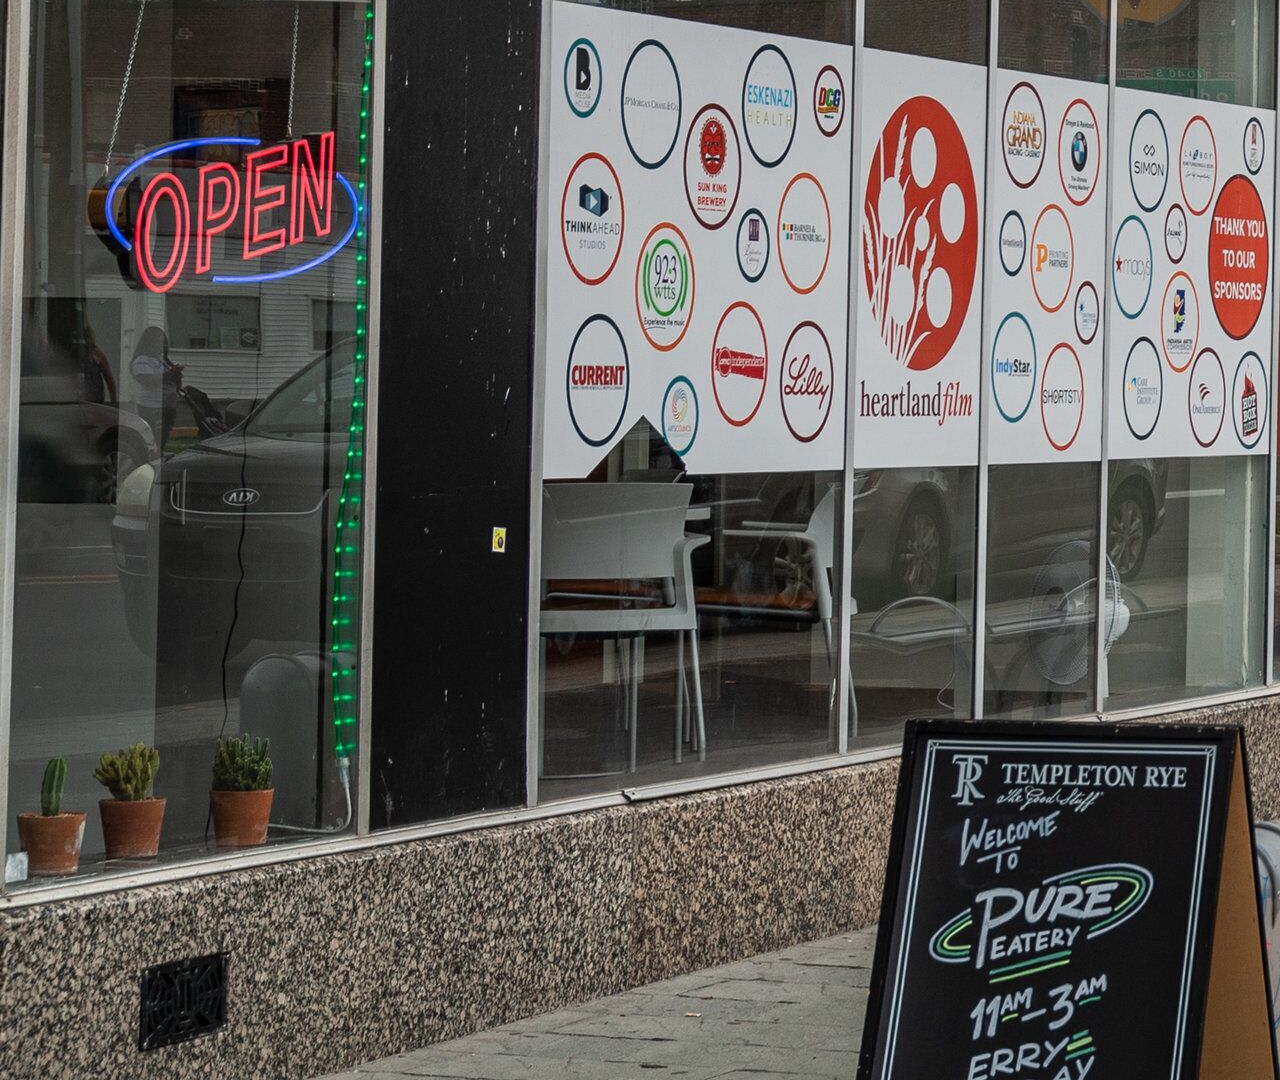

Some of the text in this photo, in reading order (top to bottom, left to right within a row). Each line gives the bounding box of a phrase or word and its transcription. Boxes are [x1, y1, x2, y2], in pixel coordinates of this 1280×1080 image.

[747, 85, 793, 108] ESKENAZI
[818, 87, 841, 107] DCG
[747, 110, 792, 127] HEALTH
[1007, 124, 1042, 150] GRAND
[1134, 160, 1164, 177] SIMON
[697, 182, 727, 194] SUN KING
[697, 196, 726, 207] BREWERY
[134, 131, 336, 294] OPEN
[565, 220, 620, 235] THINKAHEAD
[1214, 216, 1265, 238] THANK YOU
[579, 240, 606, 250] STUDIOS
[1223, 250, 1255, 269] TO OUR
[1214, 280, 1262, 301] SPONSORS
[572, 365, 625, 386] CURRENT
[784, 354, 829, 410] Lilly
[859, 380, 973, 426] heartlandfilm
[1001, 763, 1187, 788] TEMPLETON RYE
[996, 787, 1022, 805] The
[1021, 786, 1057, 810] Good
[974, 881, 1119, 969] PURE
[990, 925, 1081, 961] EATERY
